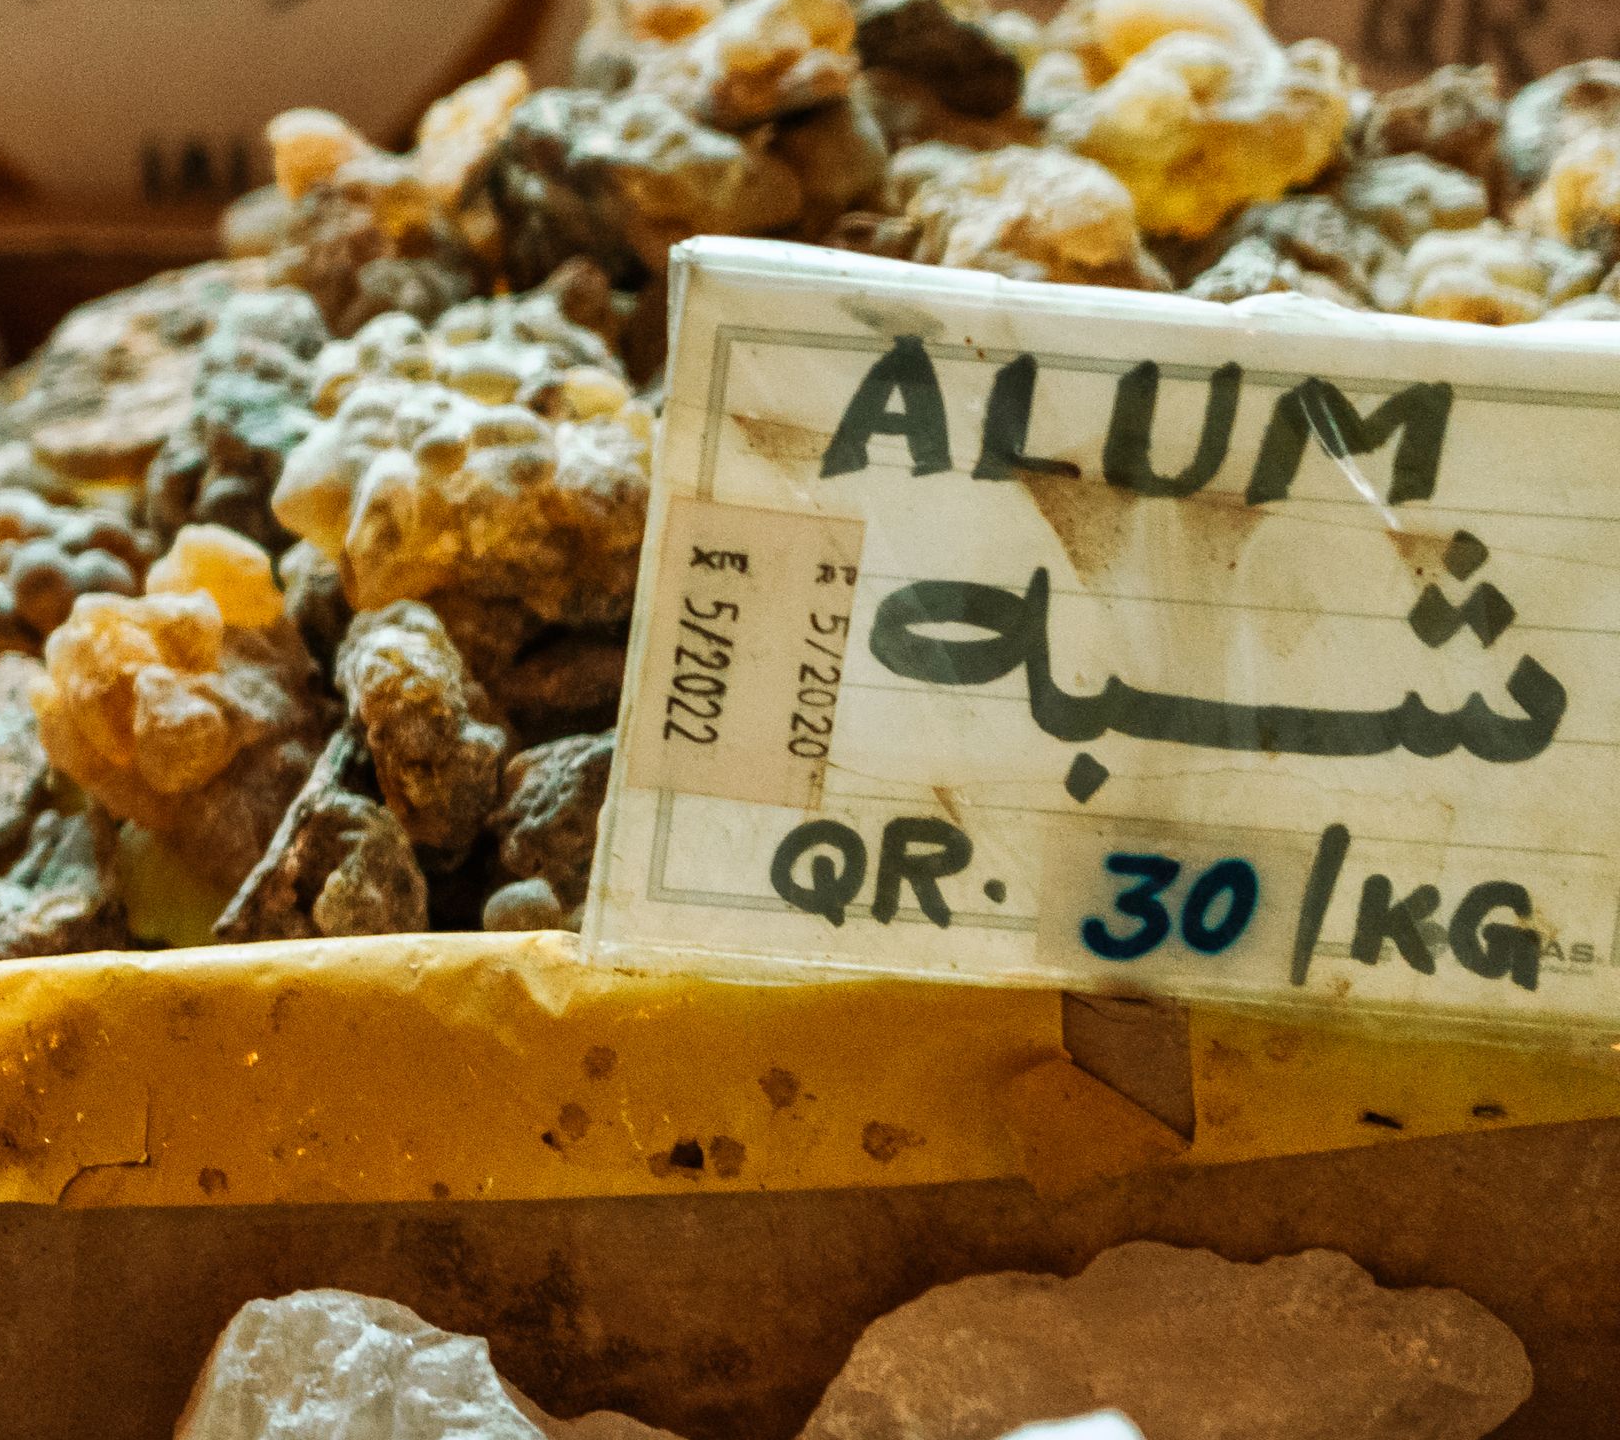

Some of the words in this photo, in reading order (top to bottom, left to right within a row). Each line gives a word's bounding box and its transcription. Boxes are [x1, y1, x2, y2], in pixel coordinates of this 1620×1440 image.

[819, 336, 1453, 507] ALUM
[663, 598, 741, 745] 5/2022
[787, 612, 850, 759] 5/2020
[1078, 853, 1260, 962] 30
